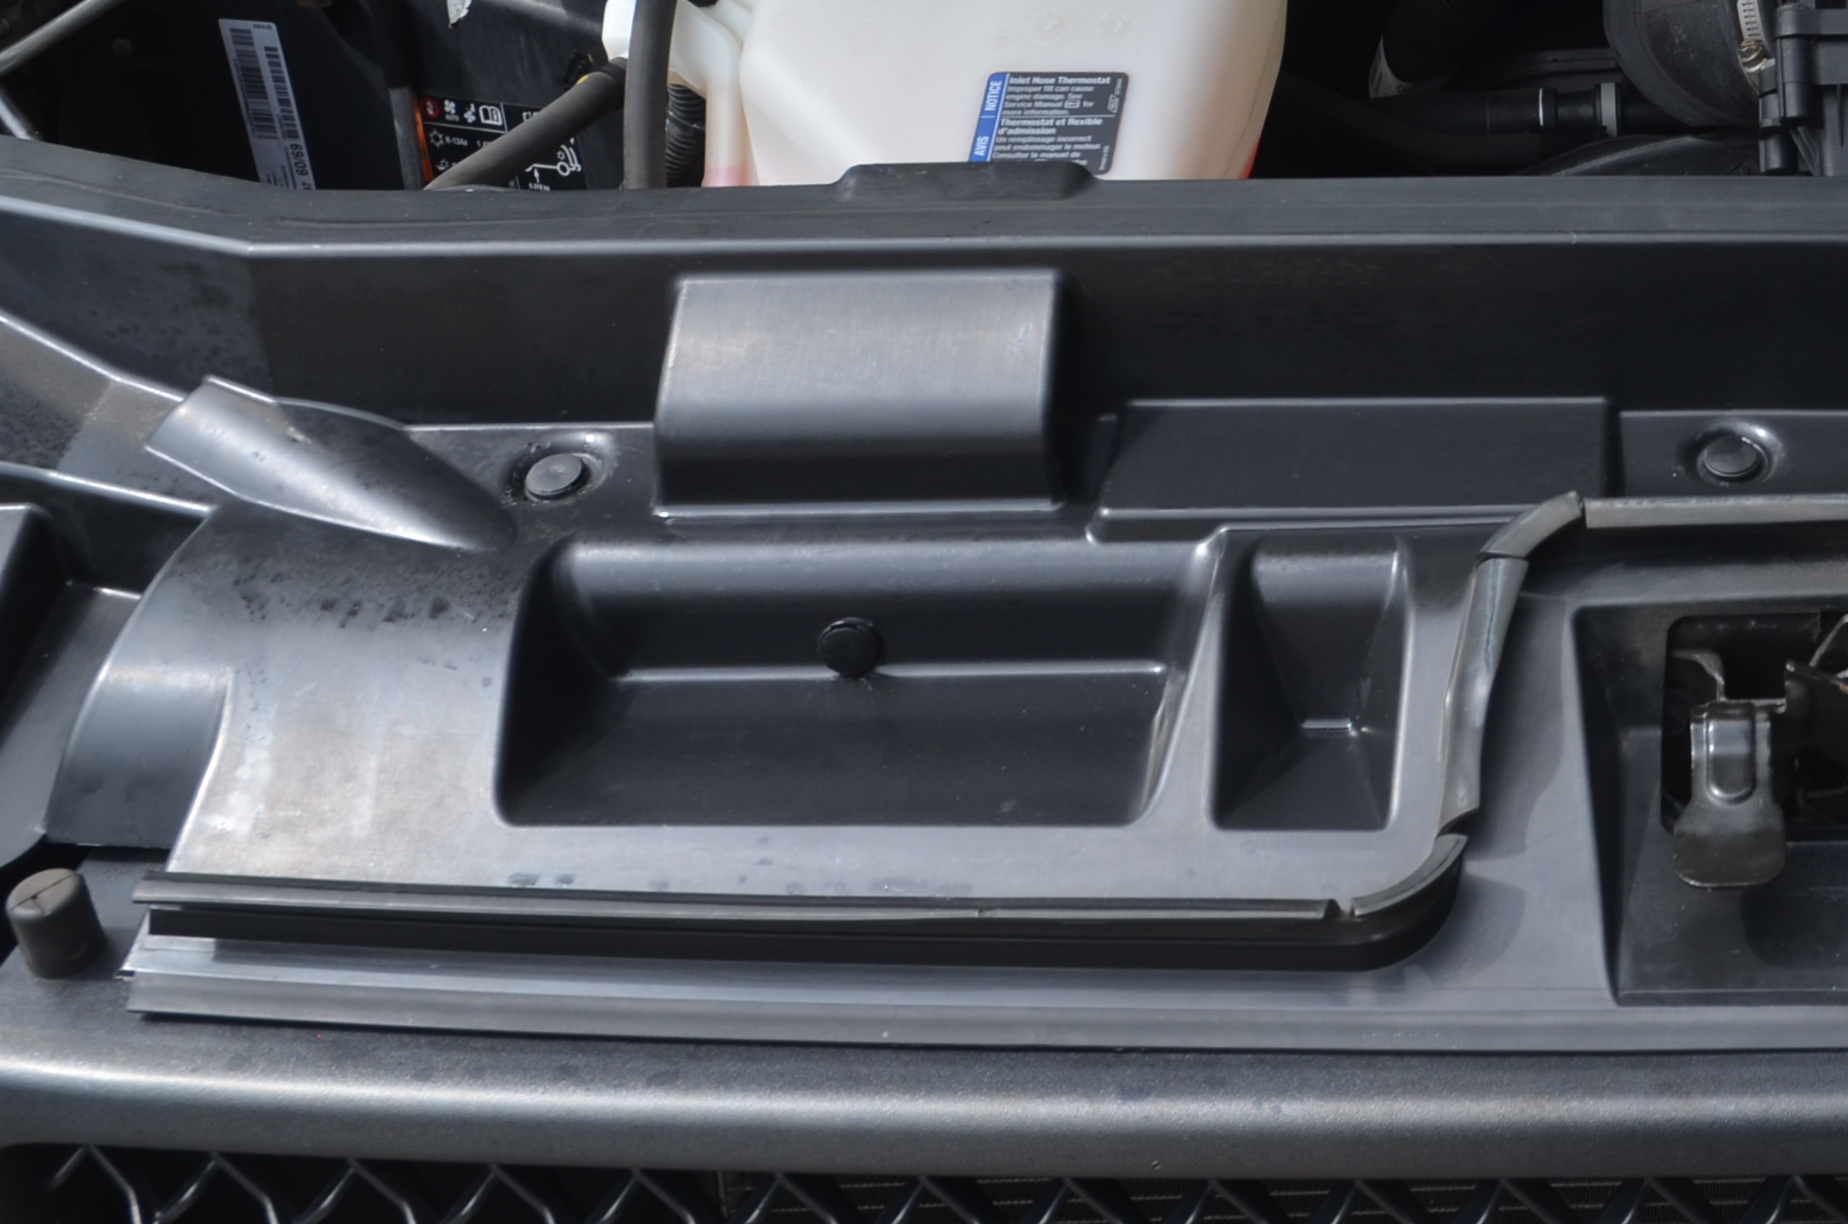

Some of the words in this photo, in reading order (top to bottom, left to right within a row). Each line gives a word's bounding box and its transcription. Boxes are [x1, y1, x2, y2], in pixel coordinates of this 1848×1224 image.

[1009, 76, 1030, 84] Inlet
[1032, 76, 1056, 84] Hose
[1058, 76, 1111, 85] Thermostat
[1007, 85, 1042, 93] Improper
[984, 81, 1002, 111] NOTICE
[1005, 93, 1032, 101] engine
[1033, 93, 1065, 101] damage.
[1023, 108, 1069, 116] information.
[1067, 118, 1103, 126] flexible
[997, 127, 1056, 135] d'admission
[1008, 136, 1055, 145] remplissage
[973, 136, 989, 156] AVIS
[993, 144, 1011, 152] peut
[1012, 144, 1064, 152] endommager
[290, 143, 308, 175] 60/69
